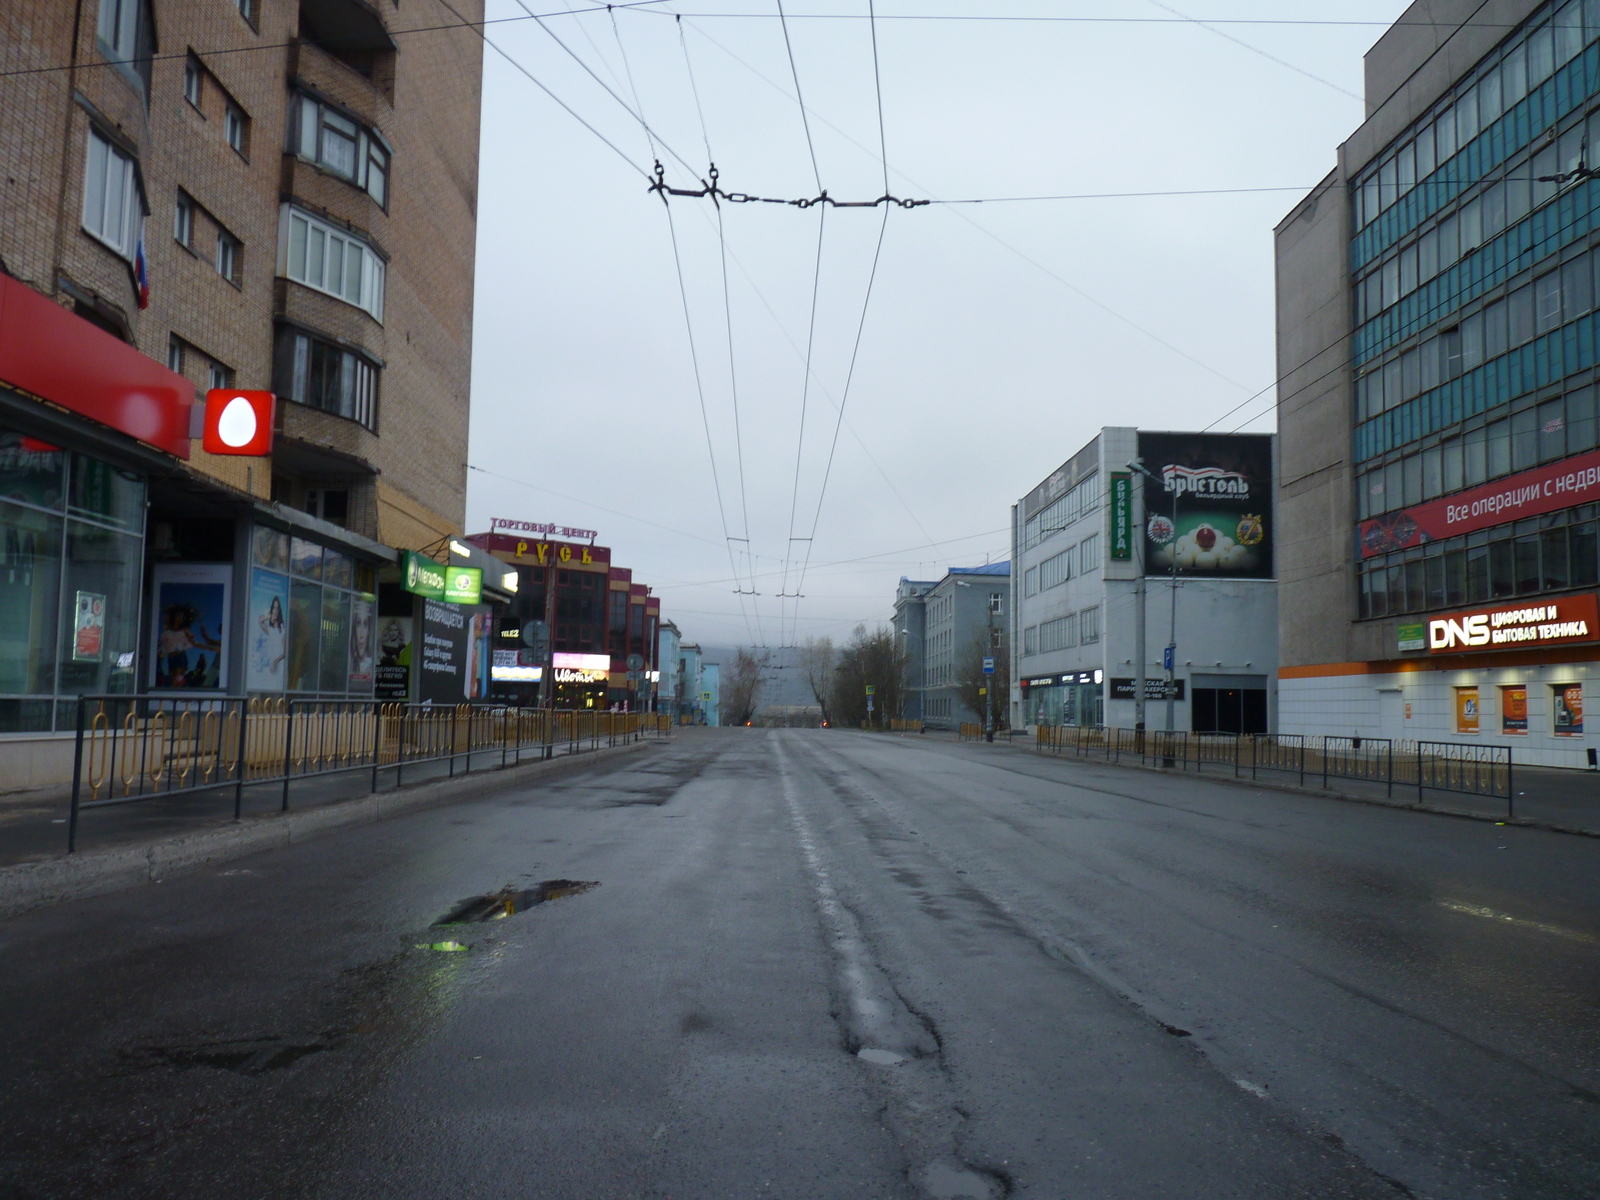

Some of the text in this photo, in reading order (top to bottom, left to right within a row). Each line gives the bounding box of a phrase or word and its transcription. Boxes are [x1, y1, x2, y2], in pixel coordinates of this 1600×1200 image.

[1163, 473, 1249, 499] Бристоль
[1195, 491, 1250, 500] бильярдный клуб
[1446, 505, 1469, 524] Все
[1471, 483, 1540, 515] операции
[1543, 480, 1552, 496] с
[490, 517, 598, 538] ТОРГОВЫЙ ЦЕНТР
[515, 541, 592, 564] РУСЬ
[1491, 605, 1557, 628] ЦИФРОВАЯ И
[501, 629, 520, 638] TELE2
[1429, 614, 1491, 649] DNS
[1491, 620, 1588, 644] БЫТОВАЯ ТЕХНИКА
[554, 668, 595, 683] Цветы
